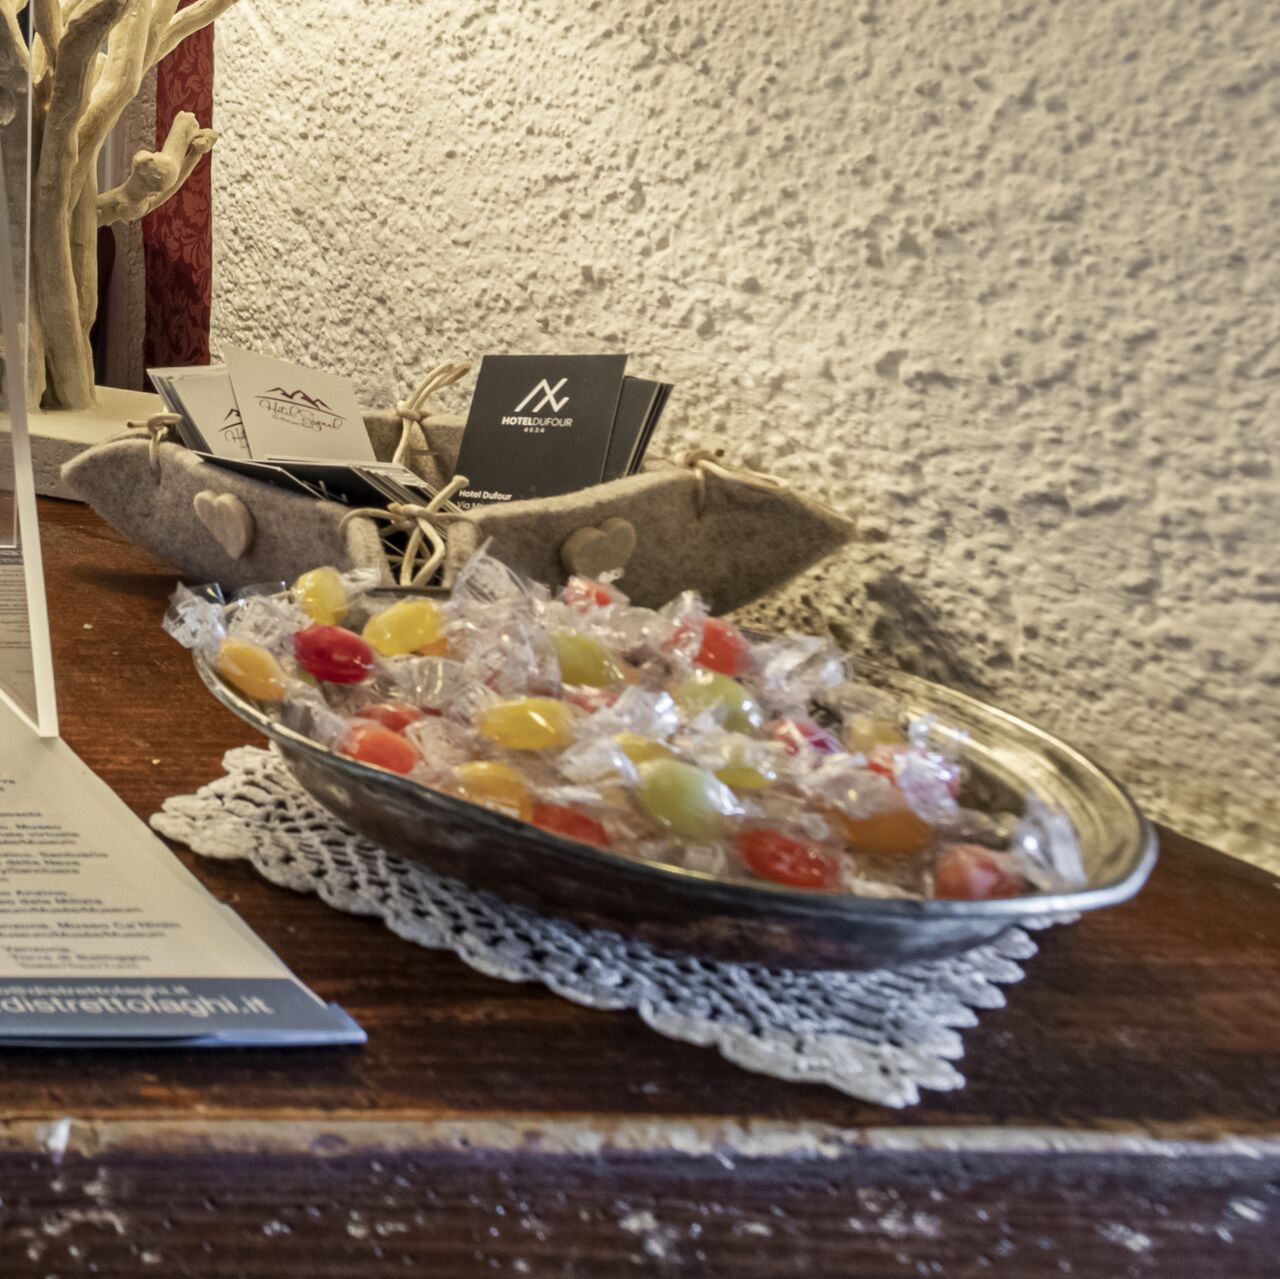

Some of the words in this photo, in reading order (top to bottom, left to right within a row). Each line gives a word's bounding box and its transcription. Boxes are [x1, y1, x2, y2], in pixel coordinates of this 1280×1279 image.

[501, 416, 574, 427] HOTELDUFOUR
[459, 490, 481, 499] Hotel
[482, 491, 512, 501] Dufour
[458, 502, 470, 510] Via
